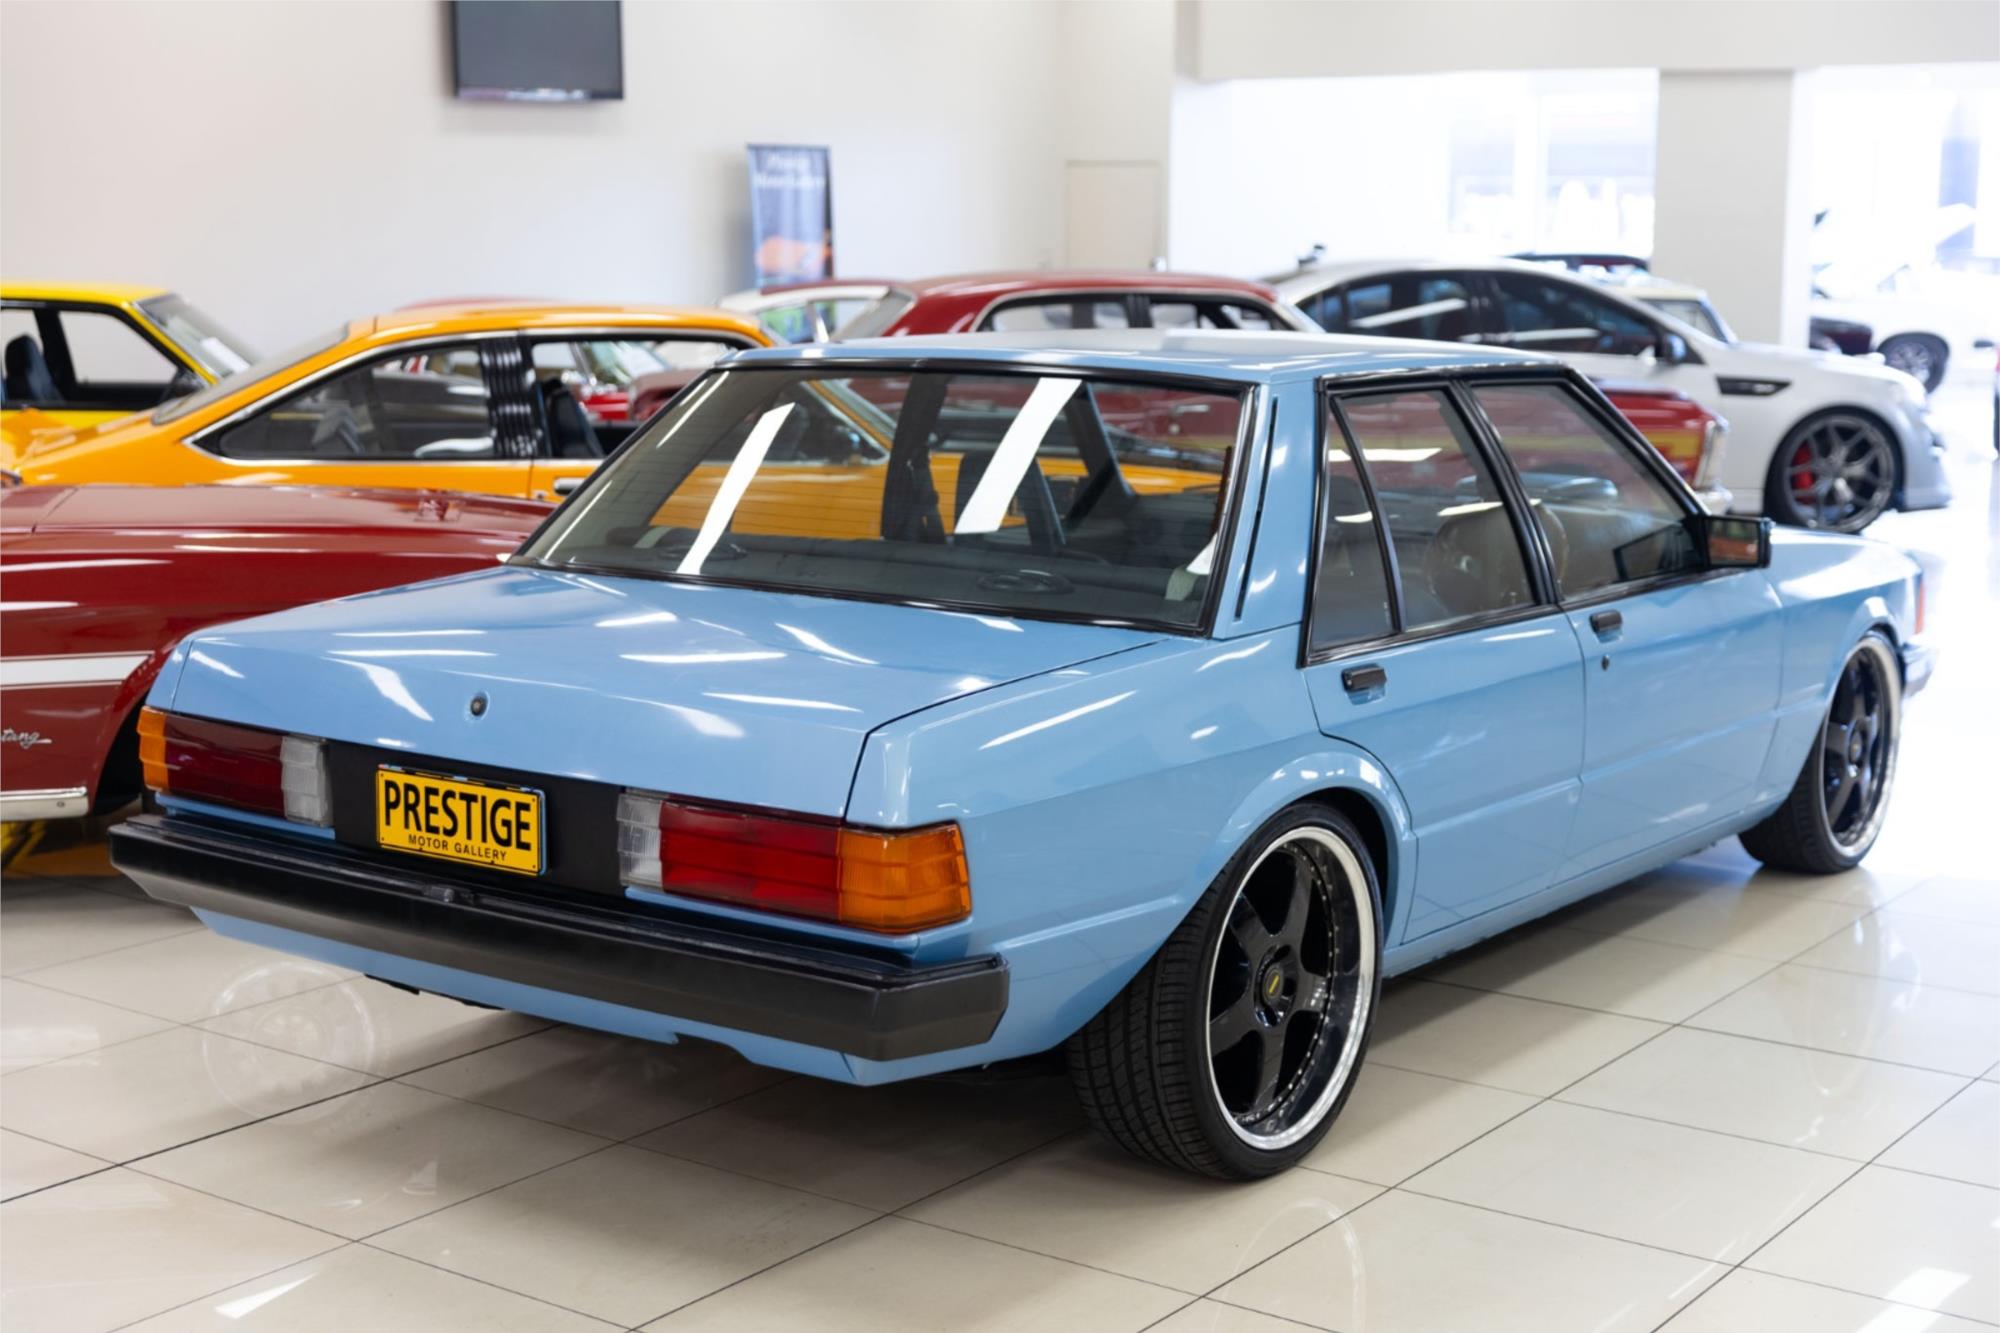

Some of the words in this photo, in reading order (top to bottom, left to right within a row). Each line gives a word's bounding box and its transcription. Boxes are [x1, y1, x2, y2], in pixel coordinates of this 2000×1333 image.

[384, 780, 531, 850] PRESTIGE
[408, 834, 449, 850] MOTOR
[454, 844, 507, 861] GALLERY
